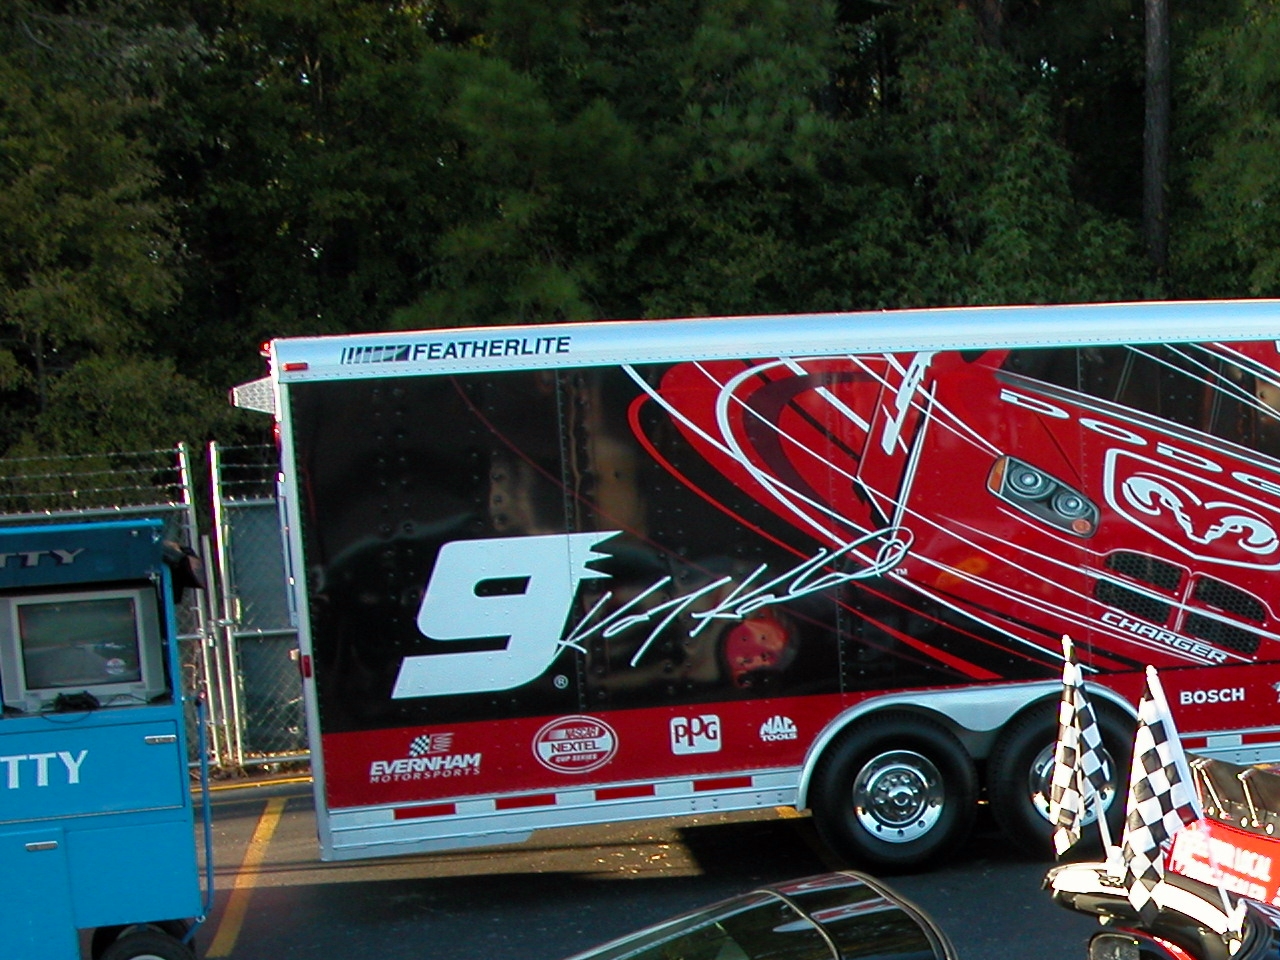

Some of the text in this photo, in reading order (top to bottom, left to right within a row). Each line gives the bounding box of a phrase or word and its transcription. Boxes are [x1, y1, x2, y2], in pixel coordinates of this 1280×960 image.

[412, 336, 572, 361] FEATHERLITE
[0, 548, 86, 569] TTY
[391, 530, 623, 700] 9
[1100, 611, 1229, 664] CHARGER
[1179, 687, 1246, 705] BOSCH
[759, 715, 798, 736] MAC
[550, 739, 603, 754] NEXTEL
[760, 732, 798, 742] TOOLS
[0, 749, 89, 790] TTY
[370, 752, 482, 777] EVERNHAM
[369, 767, 481, 784] MOTORSPORTS
